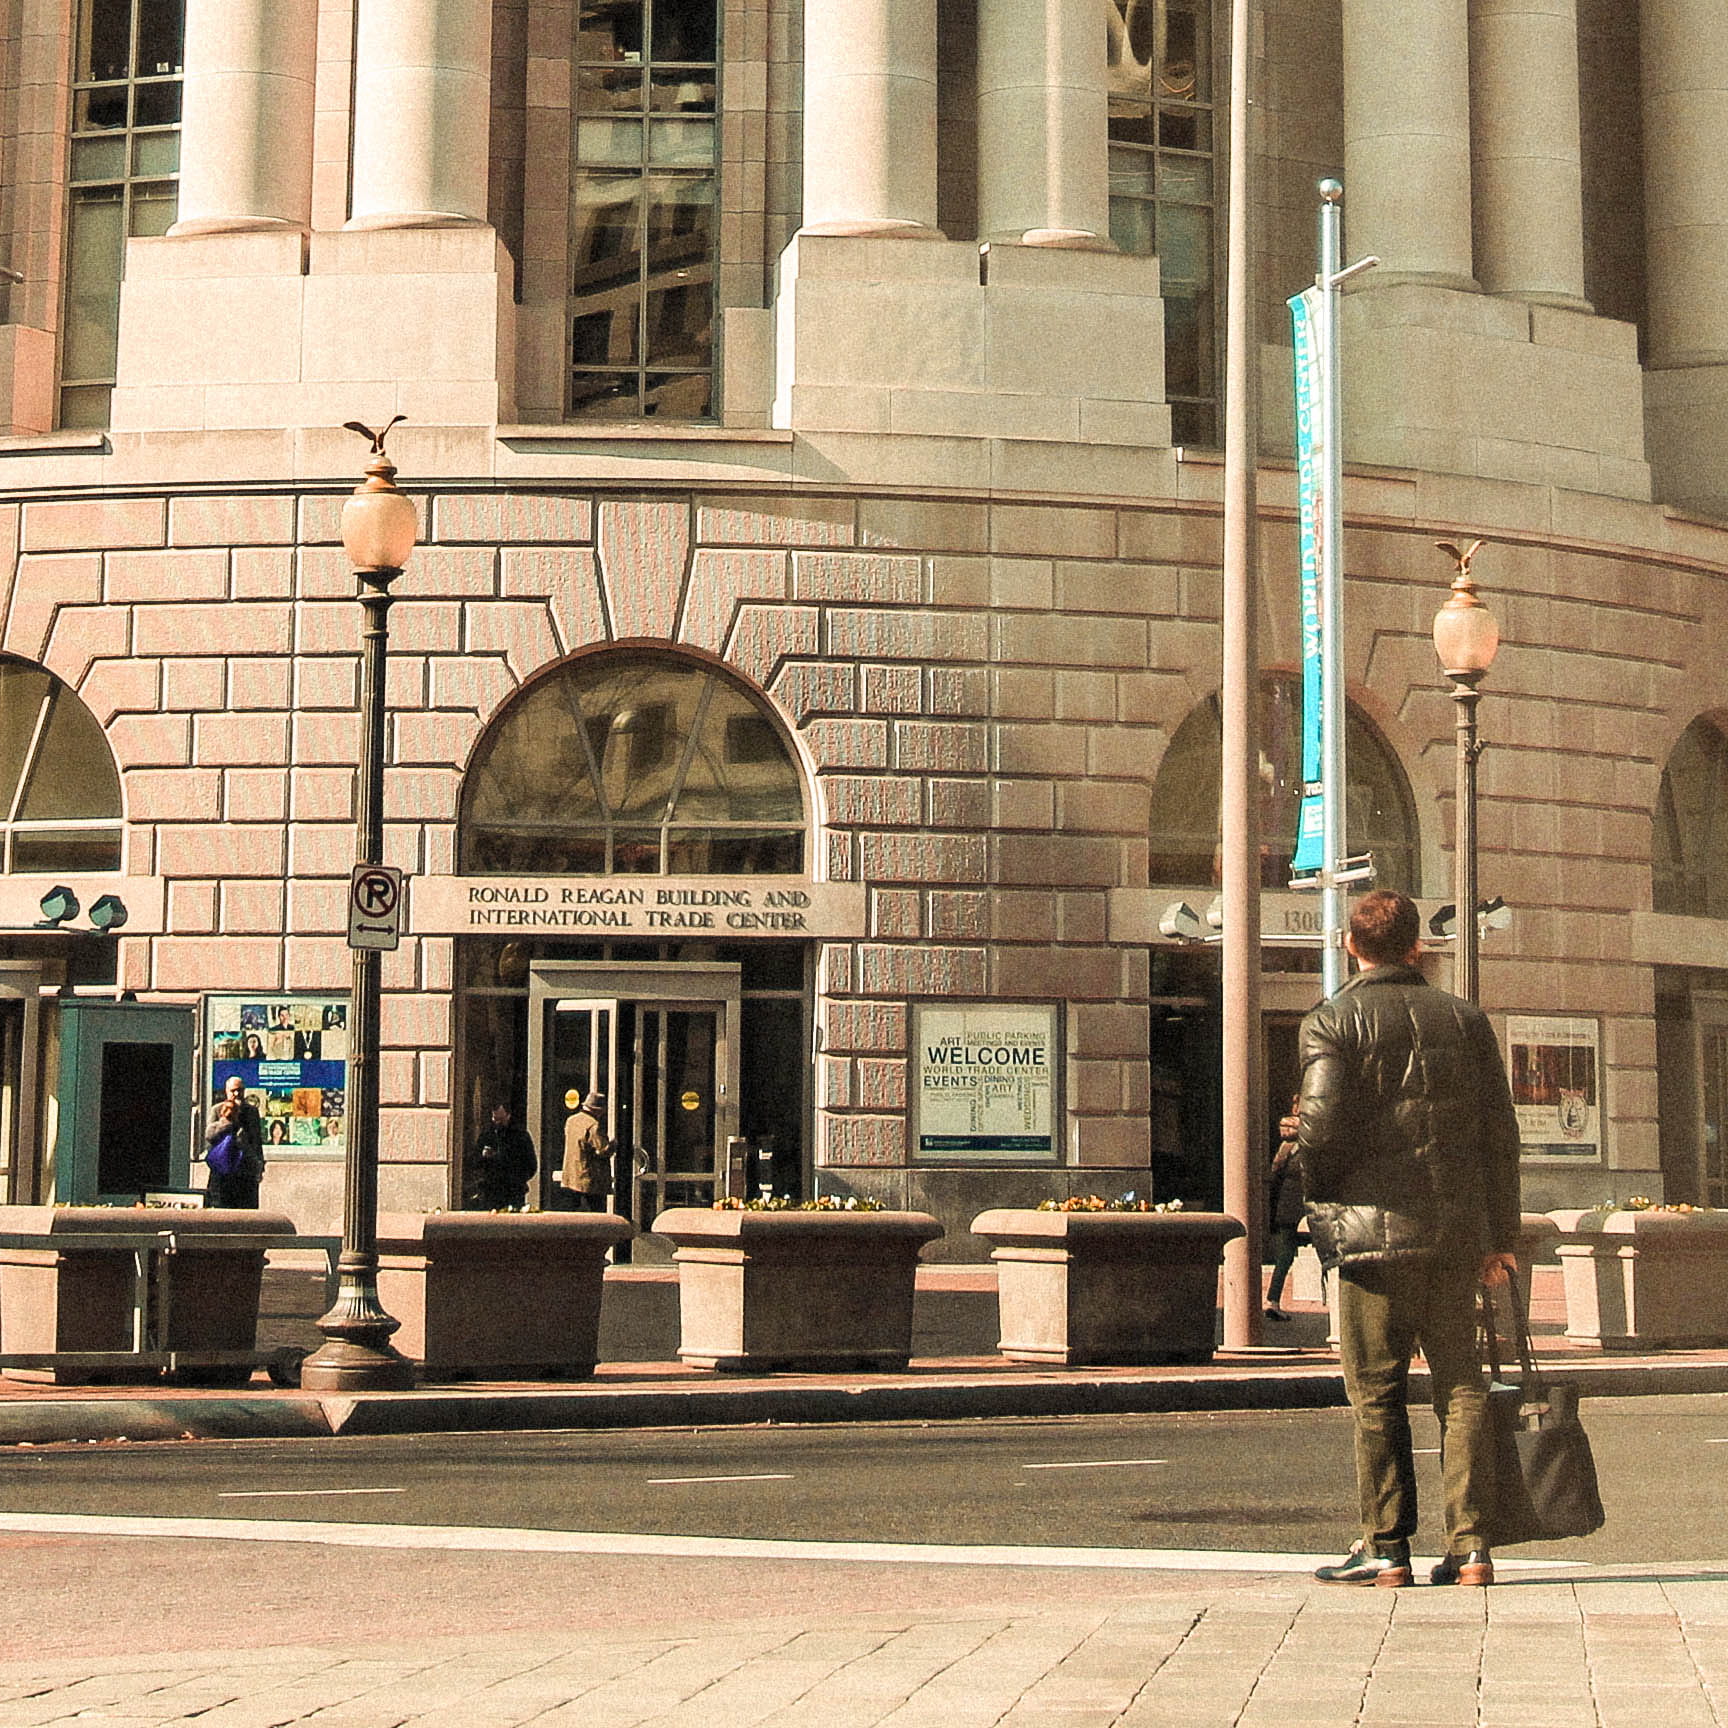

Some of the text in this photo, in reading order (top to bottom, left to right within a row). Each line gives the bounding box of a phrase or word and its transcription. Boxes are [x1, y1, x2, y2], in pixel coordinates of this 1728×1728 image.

[1295, 319, 1320, 659] WORLD TRADE CENTER
[469, 887, 811, 909] RONALD REAGAN BUILDING AND
[469, 909, 809, 930] INTERNATIONAL TRADE CENTER
[940, 1036, 961, 1046] ART
[928, 1047, 1045, 1065] WELCOME
[923, 1066, 963, 1074] WORLD
[967, 1066, 1004, 1074] TRADE
[924, 1075, 978, 1087] EVENTS
